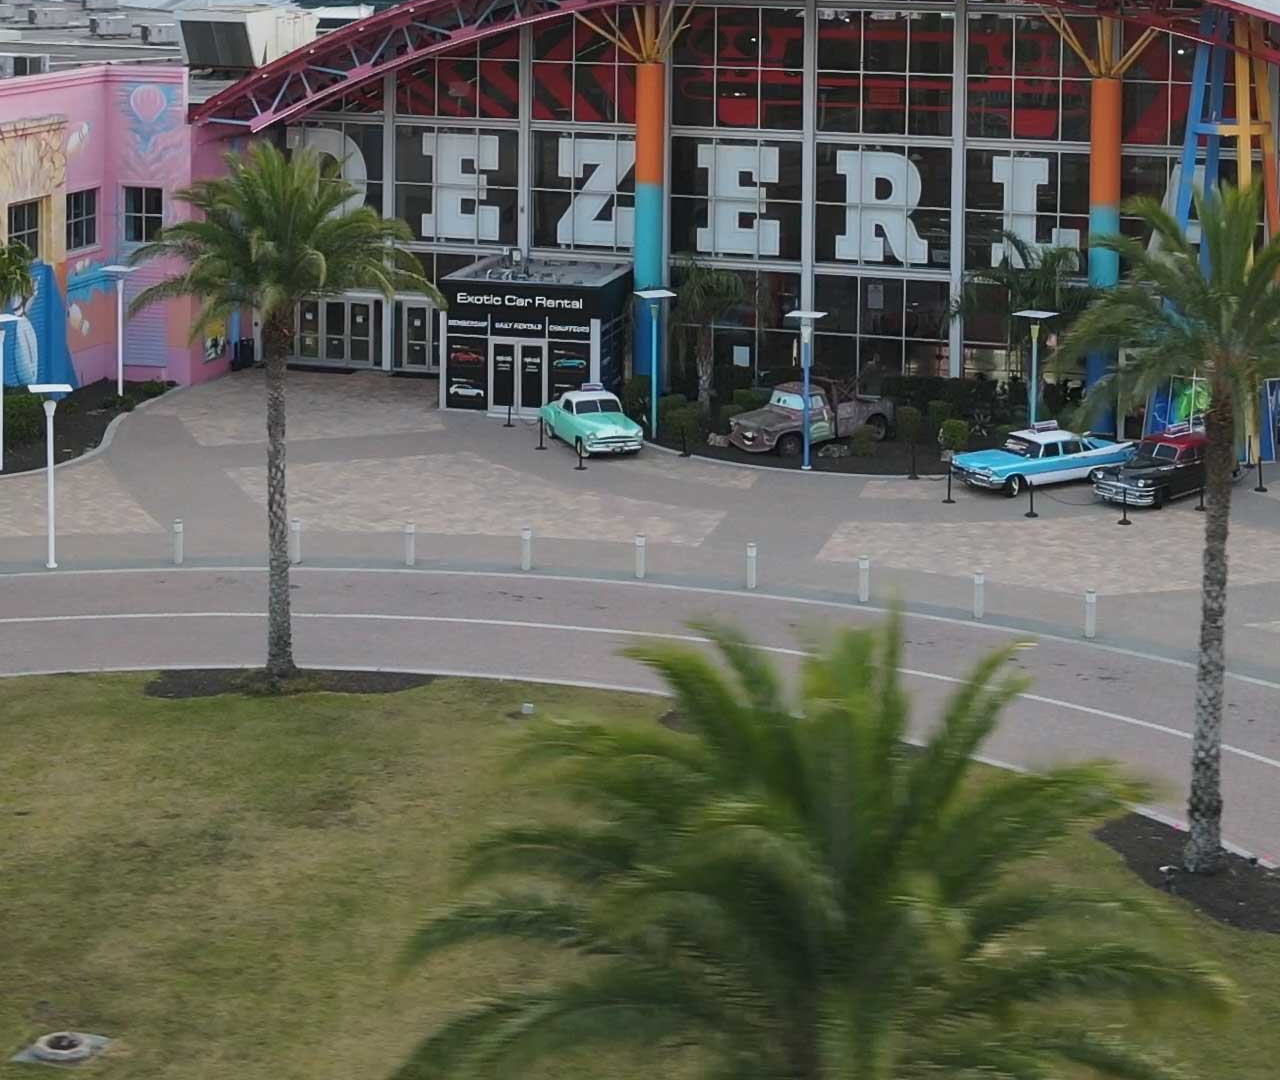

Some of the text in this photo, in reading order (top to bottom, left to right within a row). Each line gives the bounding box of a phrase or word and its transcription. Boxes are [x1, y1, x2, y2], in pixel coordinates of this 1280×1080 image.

[456, 292, 583, 309] Exotic Car Rental
